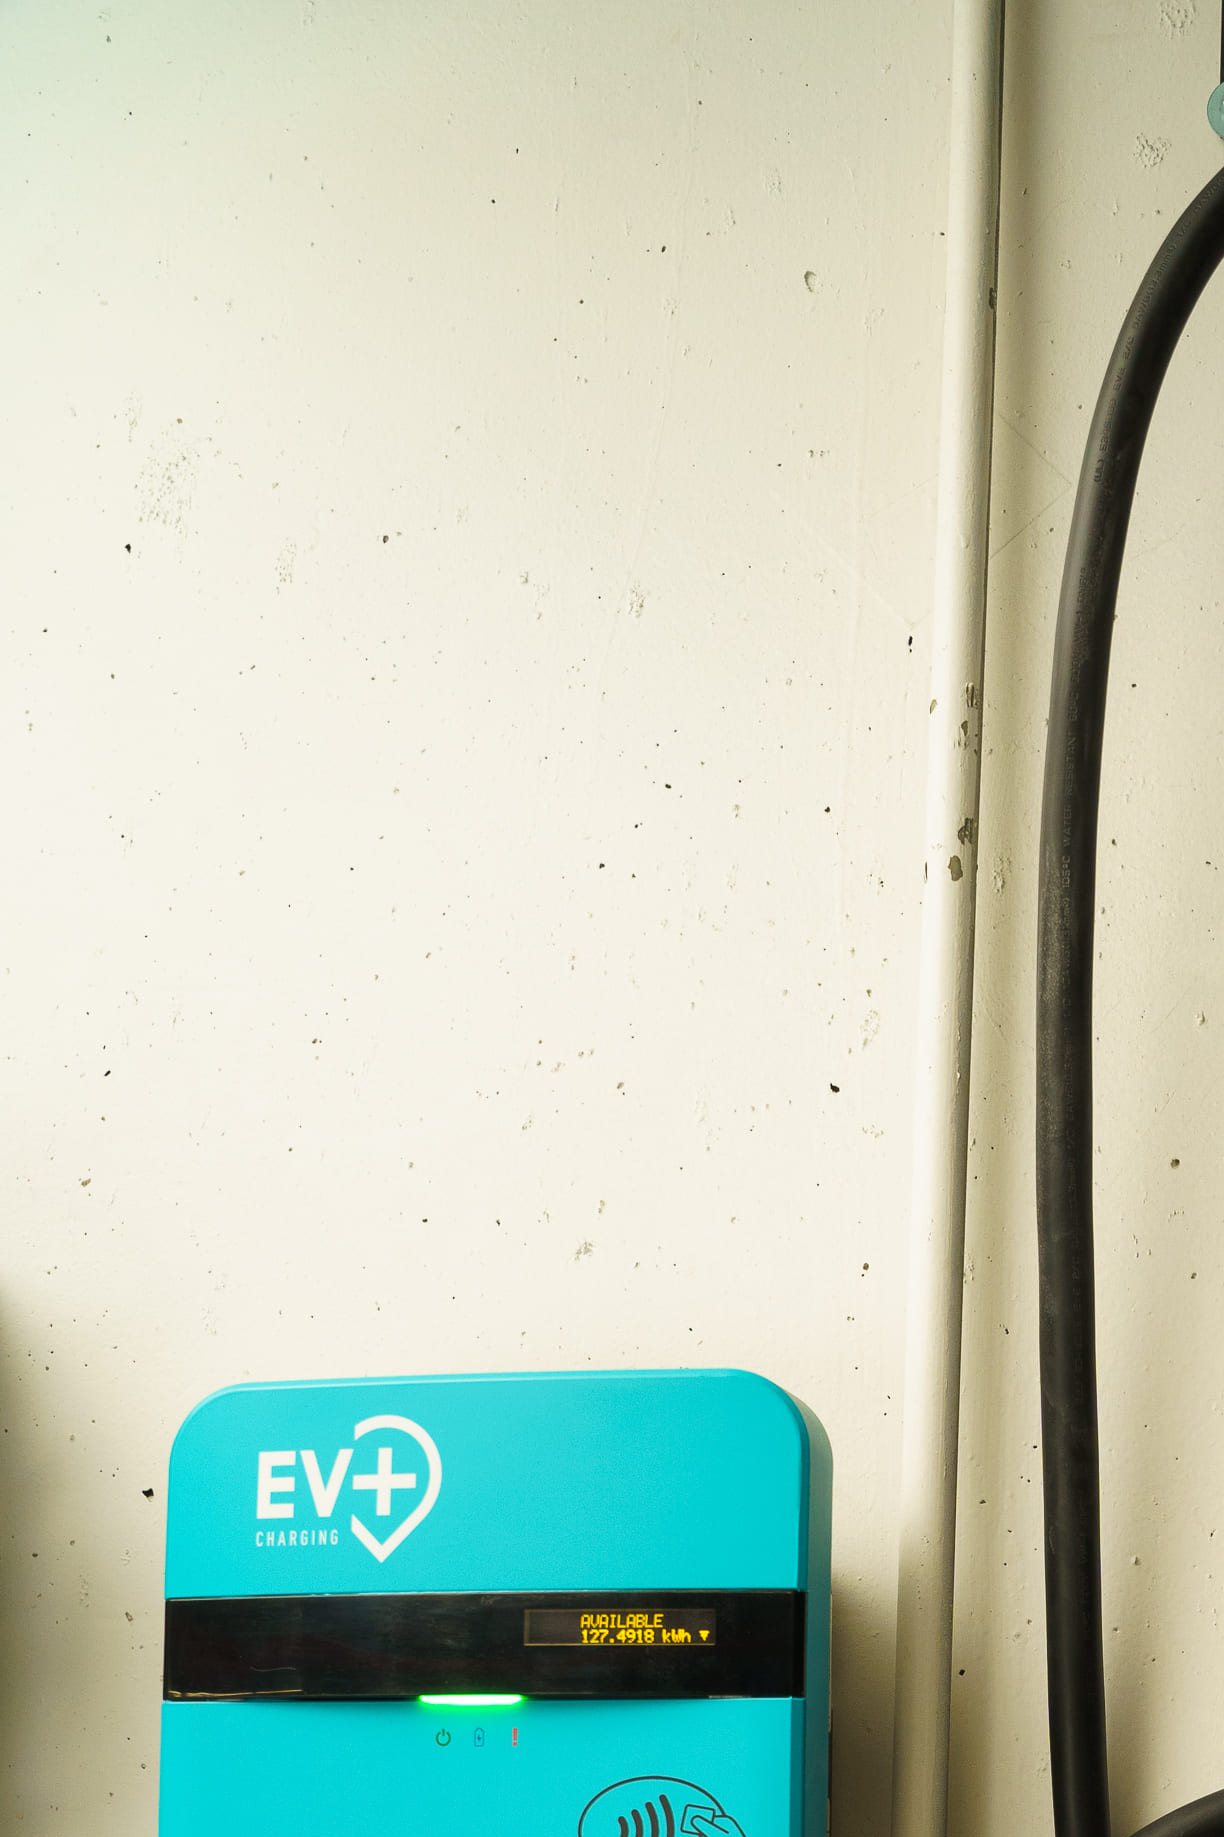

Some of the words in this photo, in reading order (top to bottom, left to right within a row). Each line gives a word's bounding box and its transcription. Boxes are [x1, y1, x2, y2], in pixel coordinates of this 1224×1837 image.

[1063, 803, 1073, 847] WATER
[256, 1529, 339, 1547] CHARGING
[580, 1613, 664, 1629] AVAILABLE
[581, 1629, 654, 1644] 127.4918
[662, 1629, 692, 1644] kWh
